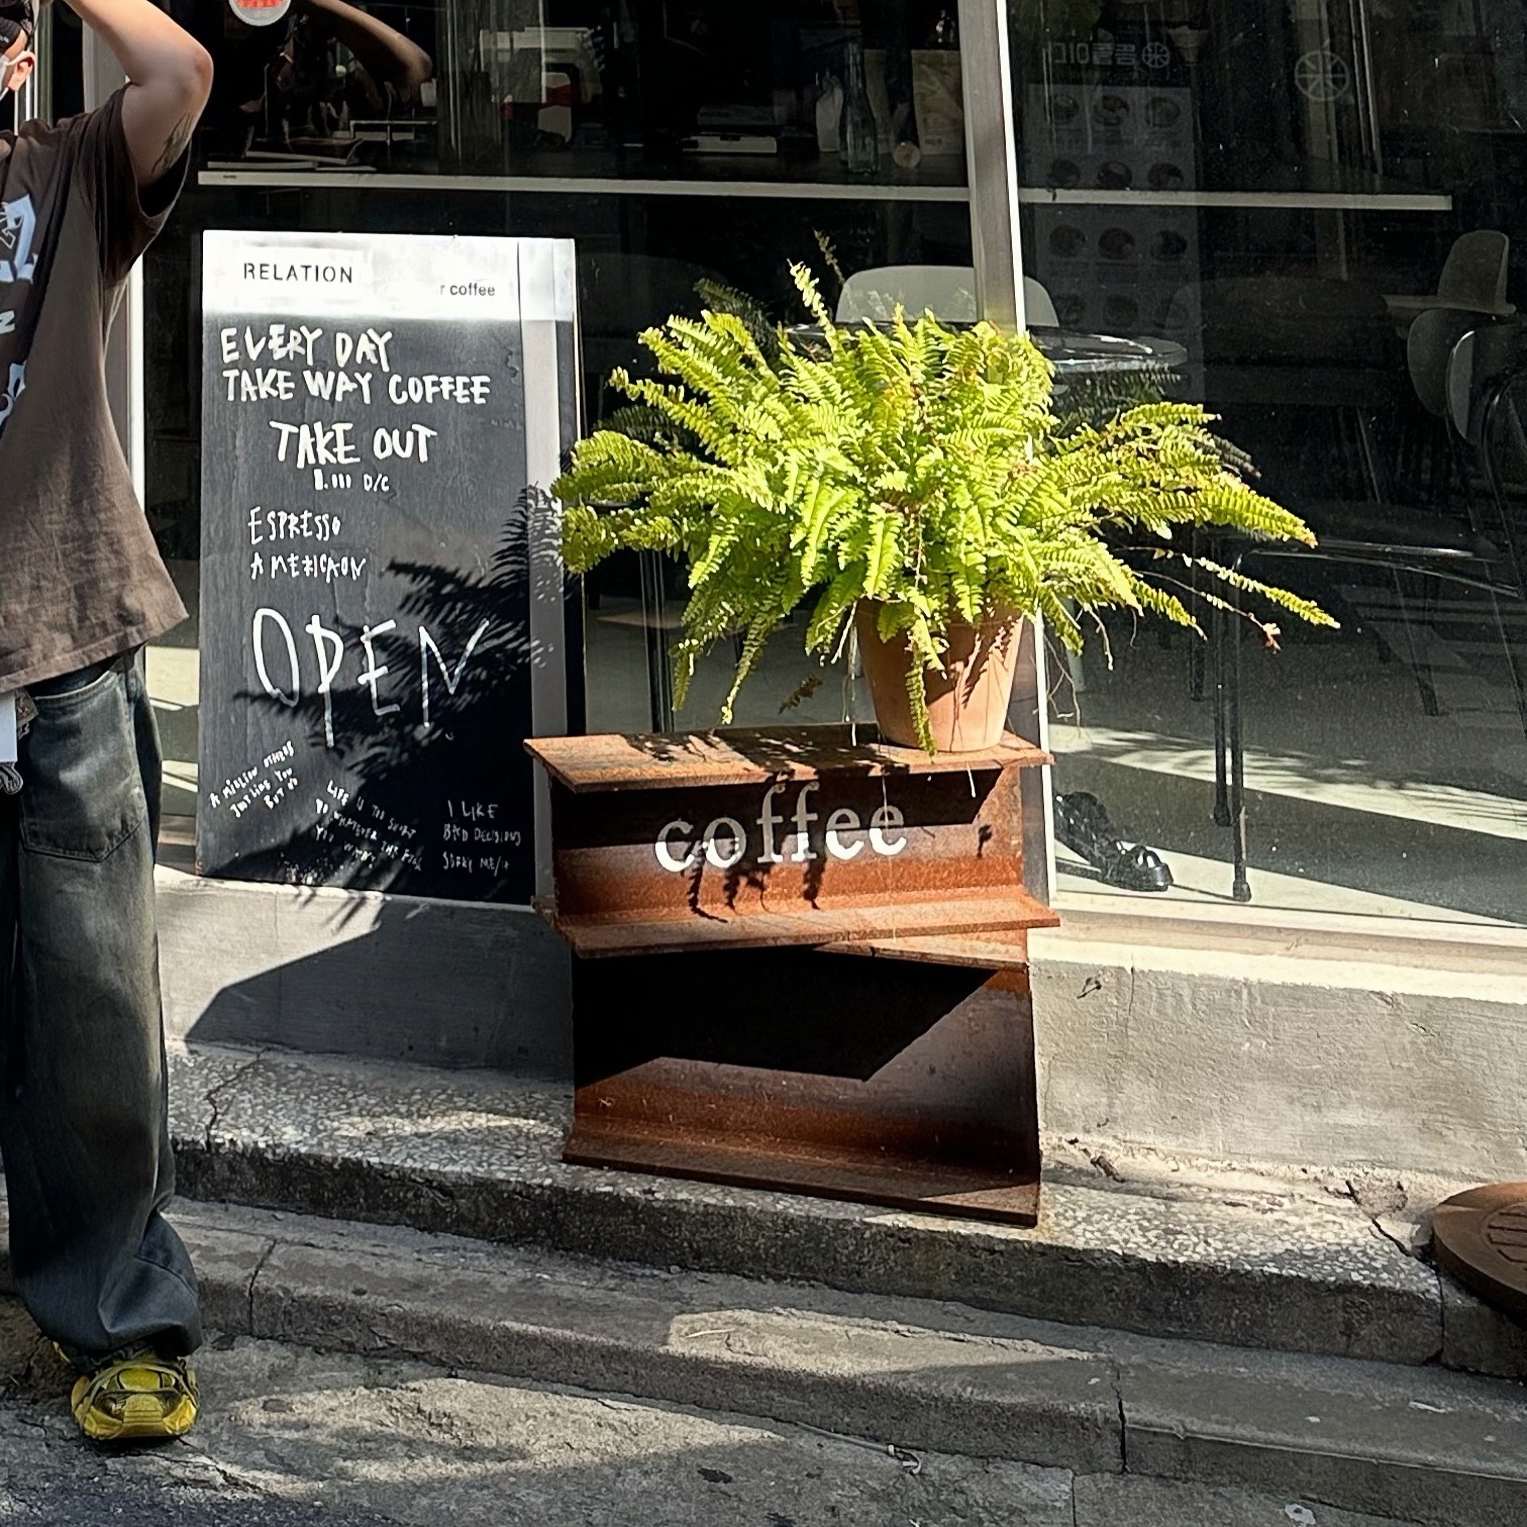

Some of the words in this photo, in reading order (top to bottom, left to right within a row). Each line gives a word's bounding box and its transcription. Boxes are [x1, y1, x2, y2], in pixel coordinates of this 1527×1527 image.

[243, 262, 353, 284] RELATION
[449, 282, 496, 297] coffee
[220, 323, 323, 367] EVERY
[335, 327, 393, 373] DAY
[222, 368, 296, 403] TAKE
[303, 369, 372, 405] WAY
[388, 374, 491, 405] COFFEE
[269, 421, 361, 469] TAKE
[373, 423, 438, 463] OUT
[248, 506, 341, 545] ESPRESSO
[253, 607, 490, 748] OPEN
[447, 799, 453, 818] I
[461, 800, 499, 821] LIKE
[655, 781, 907, 873] coffee
[443, 823, 469, 842] BAD
